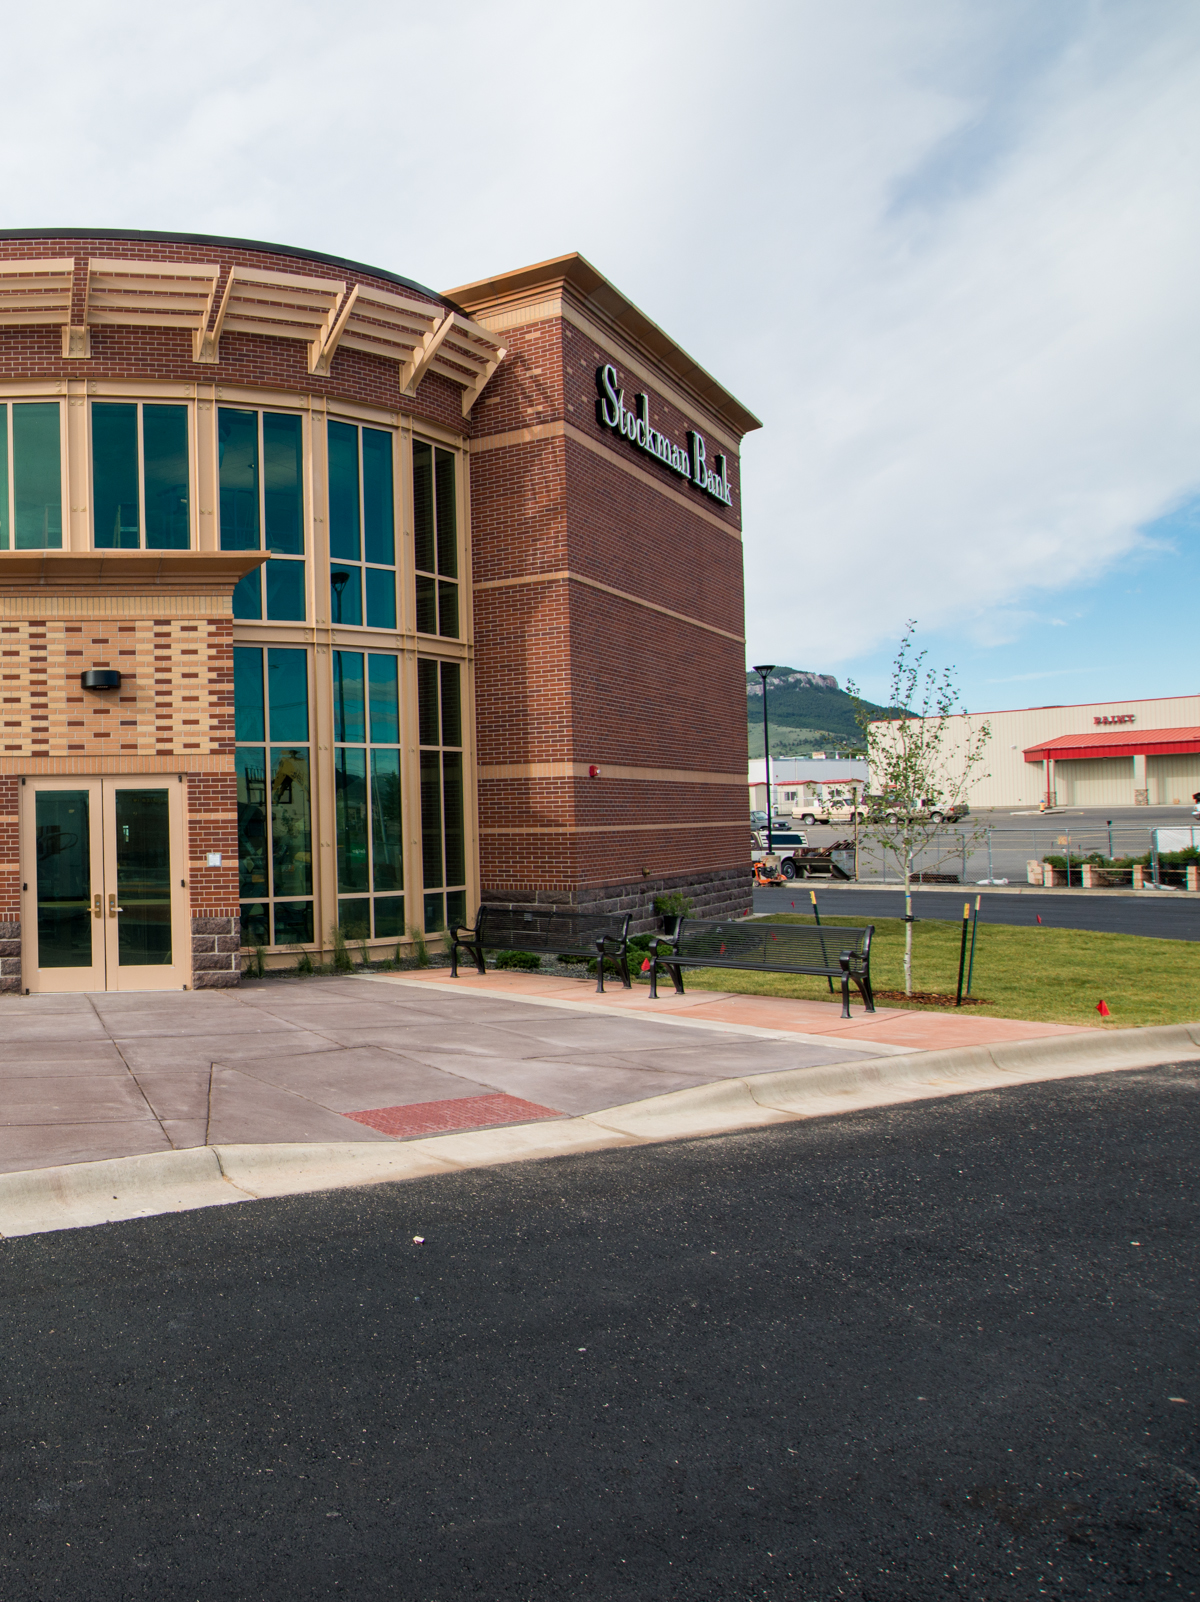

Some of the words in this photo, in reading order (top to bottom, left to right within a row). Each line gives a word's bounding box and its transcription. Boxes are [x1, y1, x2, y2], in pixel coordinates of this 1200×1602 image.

[596, 364, 691, 479] Stockman
[688, 430, 733, 507] Bank
[1093, 714, 1135, 724] PAINT
